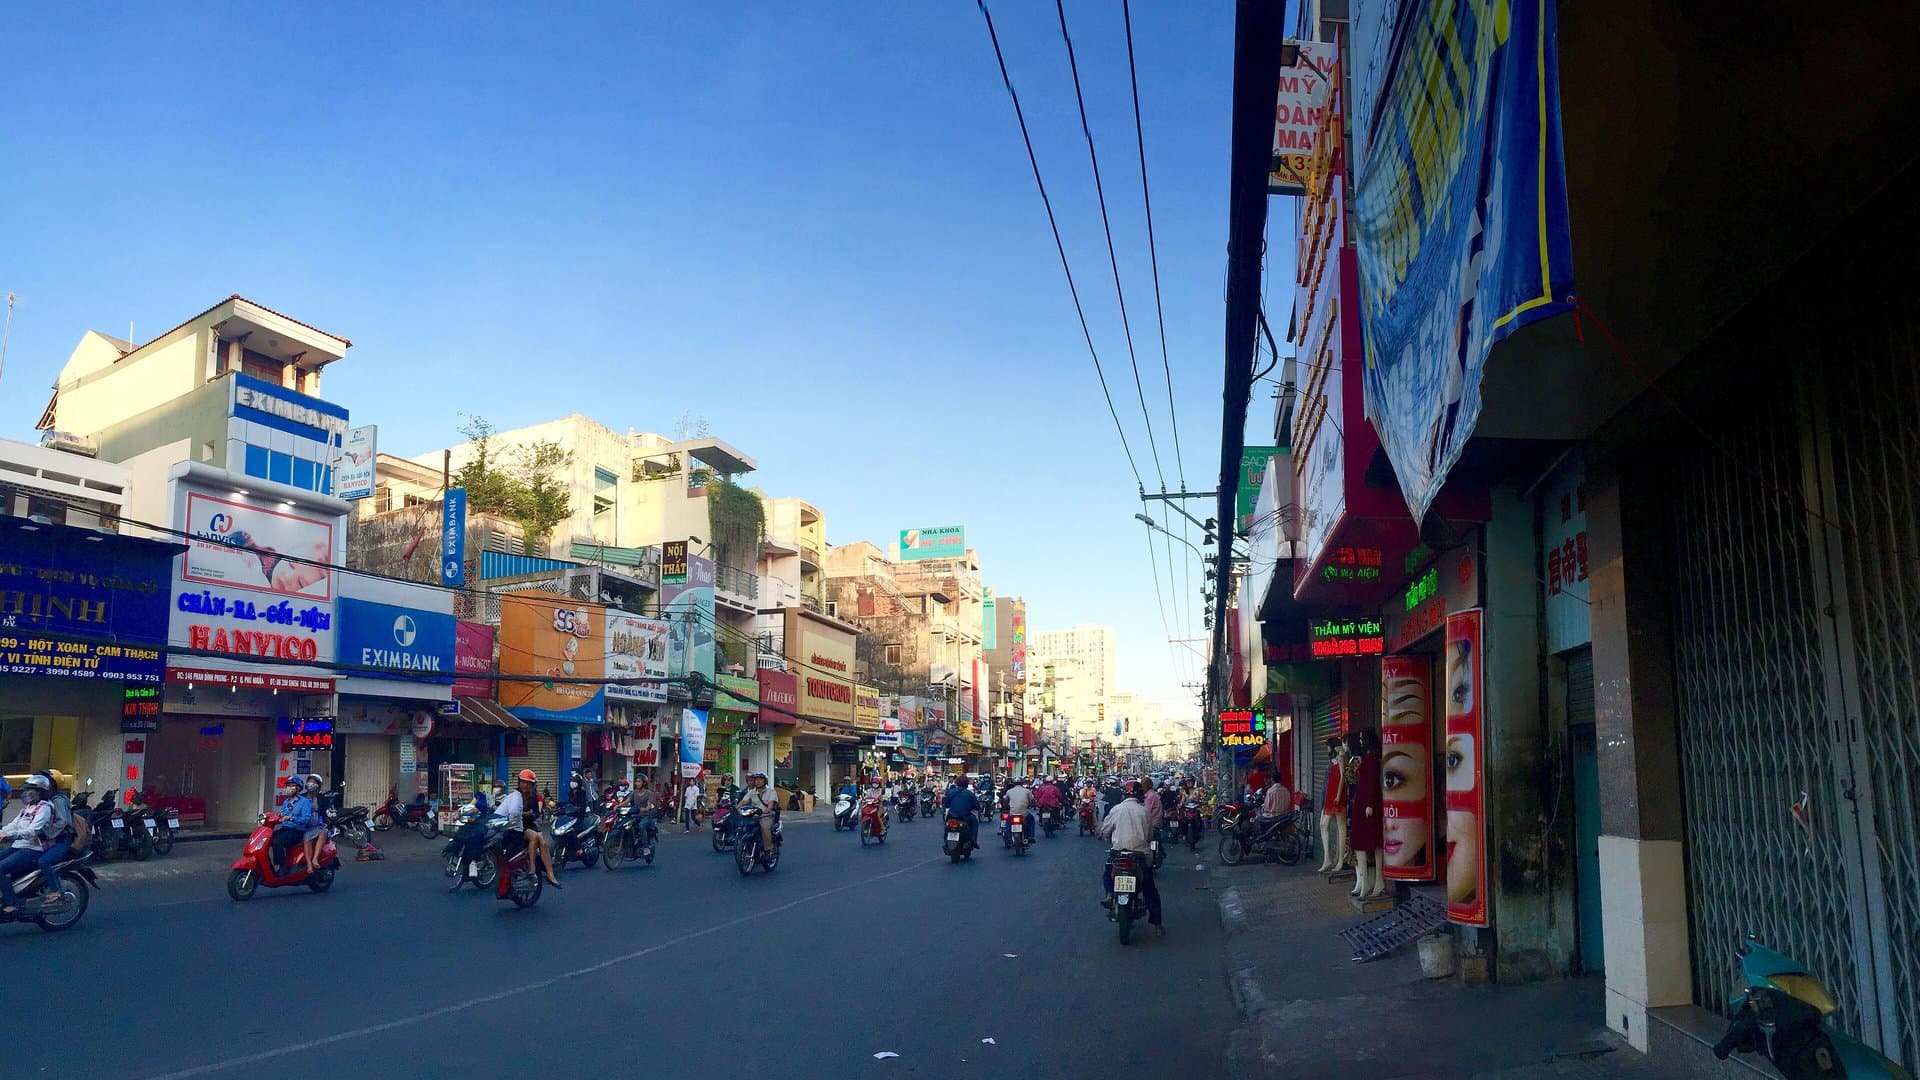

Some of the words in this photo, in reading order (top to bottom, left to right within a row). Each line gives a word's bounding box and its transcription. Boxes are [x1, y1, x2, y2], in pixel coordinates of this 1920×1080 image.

[236, 386, 348, 433] EXIMBANK
[448, 497, 456, 555] EXIMBANK
[663, 558, 686, 574] THẤT
[1314, 620, 1340, 636] THẨM
[1342, 622, 1355, 635] MỸ
[1358, 621, 1380, 636] VIỆN
[29, 639, 54, 651] HỘT
[57, 642, 87, 654] XOAN
[96, 646, 121, 657] CAM
[124, 648, 159, 660] THẠCH
[189, 624, 318, 662] HANVICO
[8, 653, 20, 664] VI
[24, 651, 51, 666] TÍNH
[54, 655, 81, 669] ĐIỆN
[83, 656, 100, 669] TỬ
[362, 647, 440, 672] EXIMBANK
[12, 665, 36, 674] 9227
[46, 668, 70, 676] 3990
[72, 669, 95, 678] 4589
[103, 671, 124, 679] 0903
[126, 673, 142, 681] 953
[145, 674, 160, 682] 751
